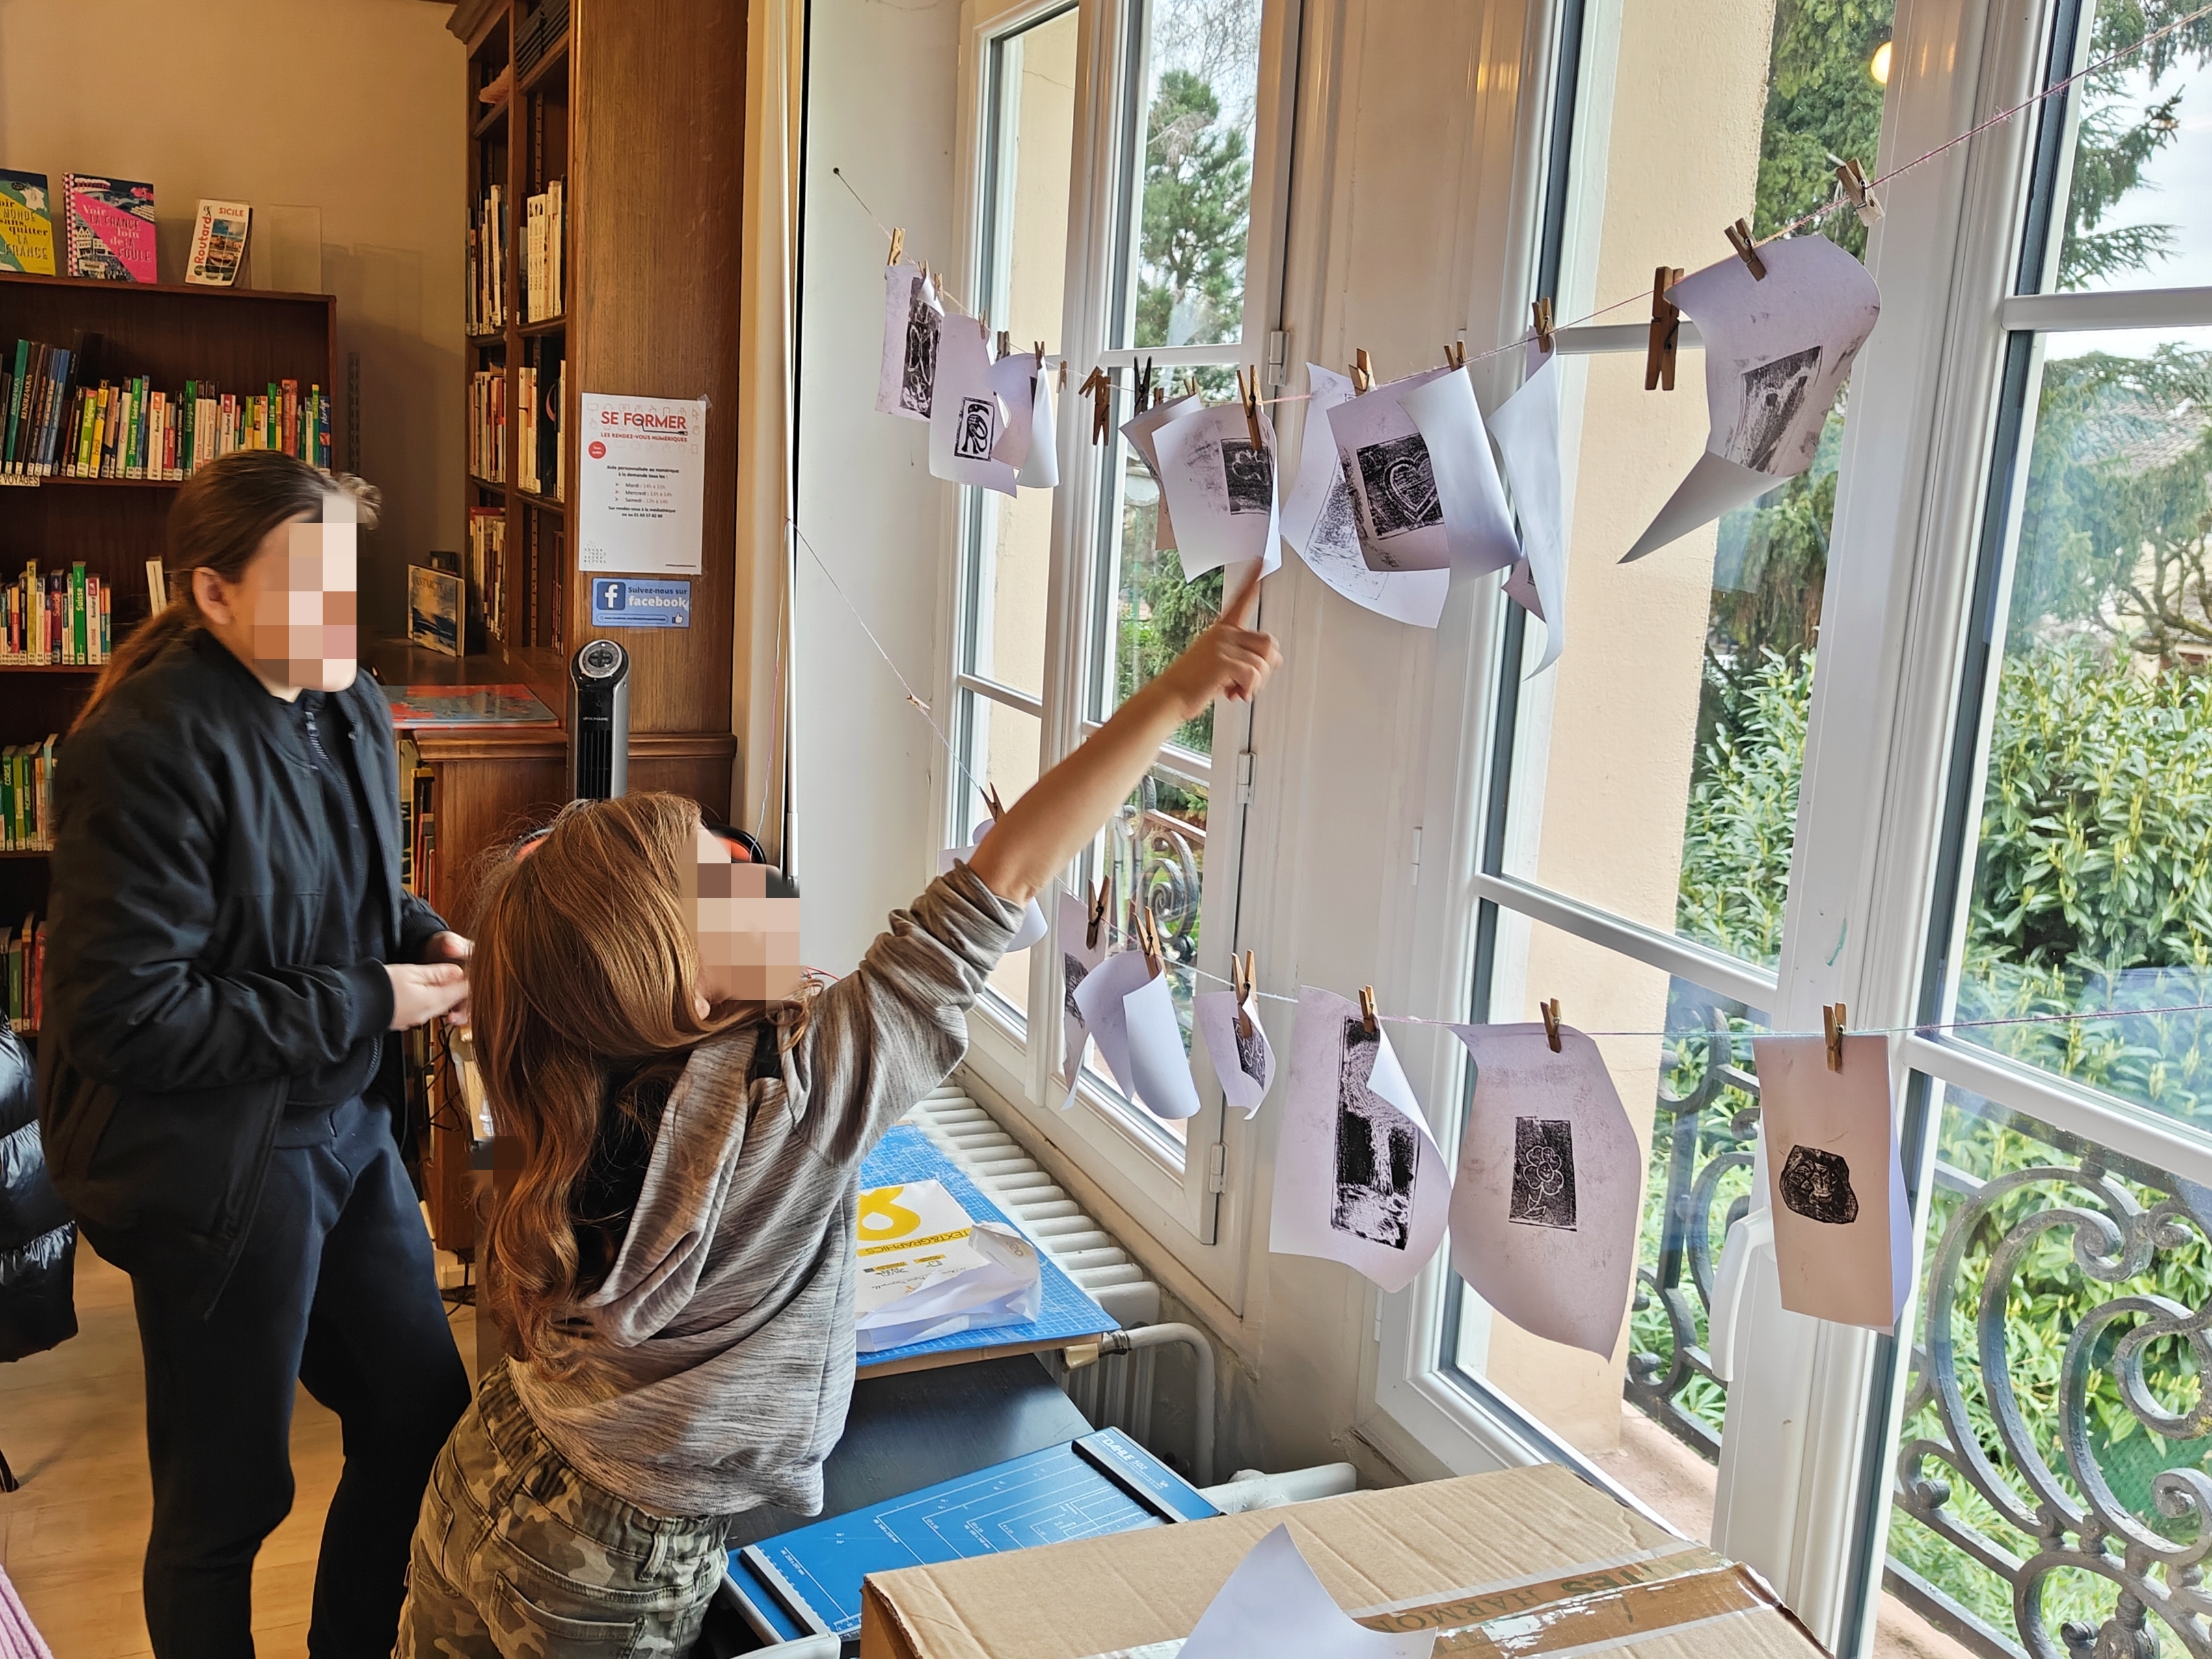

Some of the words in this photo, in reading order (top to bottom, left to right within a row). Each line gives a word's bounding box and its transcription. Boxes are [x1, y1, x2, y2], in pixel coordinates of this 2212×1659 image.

[0, 199, 16, 208] oir
[82, 204, 107, 216] Voir
[3, 209, 36, 223] MONDE
[219, 207, 244, 217] SICILE
[89, 214, 102, 227] LA
[104, 216, 141, 230] FRANCE
[8, 224, 49, 237] quitter
[17, 234, 28, 245] LA
[194, 216, 212, 264] Routard
[118, 247, 152, 263] FOULE
[600, 411, 619, 425] SE
[623, 412, 687, 430] FORMER
[3, 474, 39, 485] VOYAGES
[627, 586, 673, 595] Suivez-nous
[75, 587, 84, 612] Suisse
[628, 595, 686, 607] facebook
[865, 1229, 969, 1256] TEXT&GRAPHICS
[1101, 1437, 1135, 1461] DAHLE
[1131, 1459, 1148, 1471] 502
